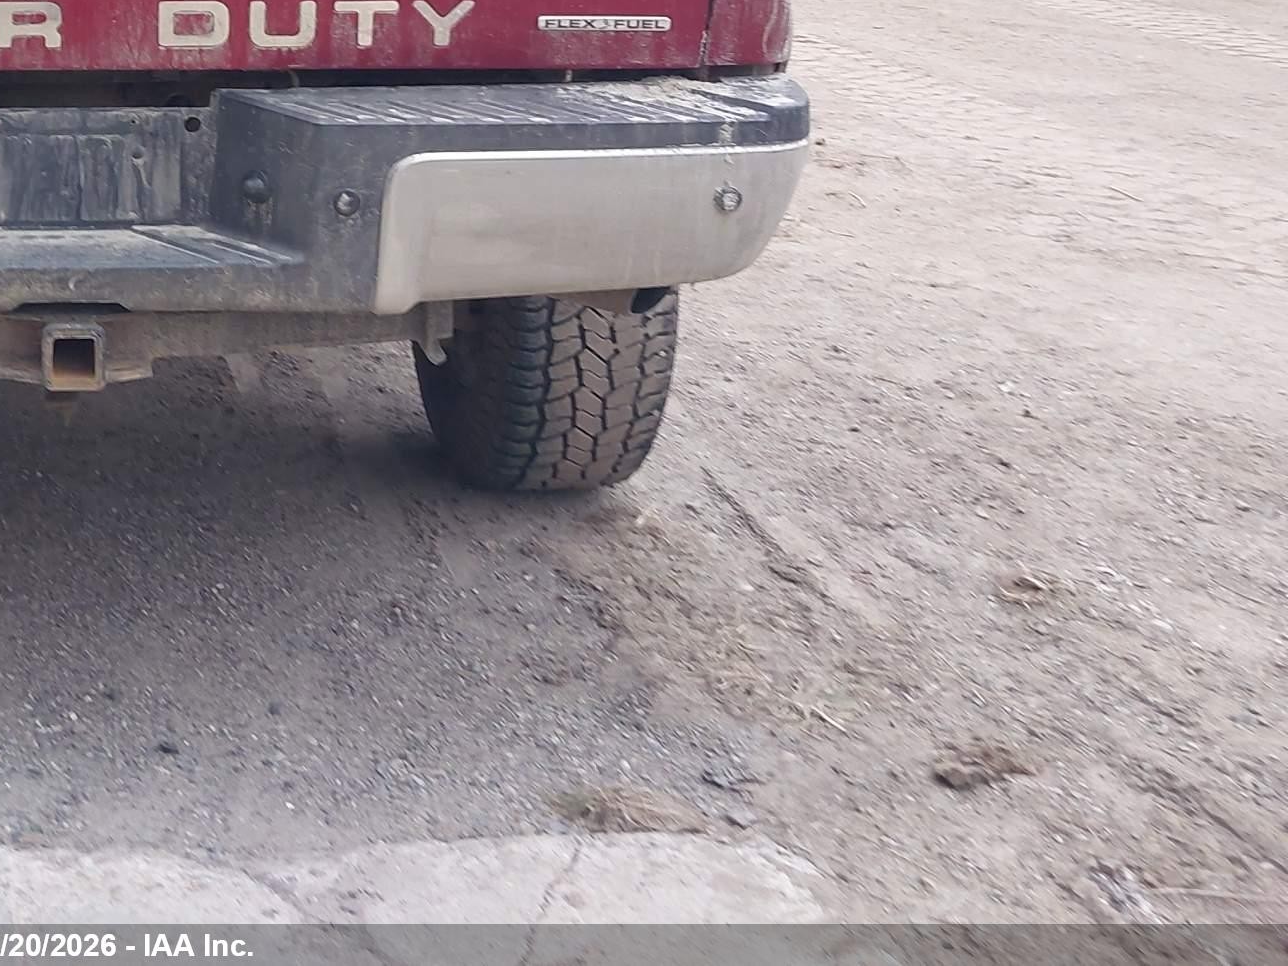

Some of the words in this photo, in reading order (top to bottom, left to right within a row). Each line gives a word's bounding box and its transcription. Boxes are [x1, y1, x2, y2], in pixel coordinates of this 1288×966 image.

[158, 0, 476, 48] DUTY
[544, 18, 597, 29] FLEX
[613, 18, 666, 30] FUEL
